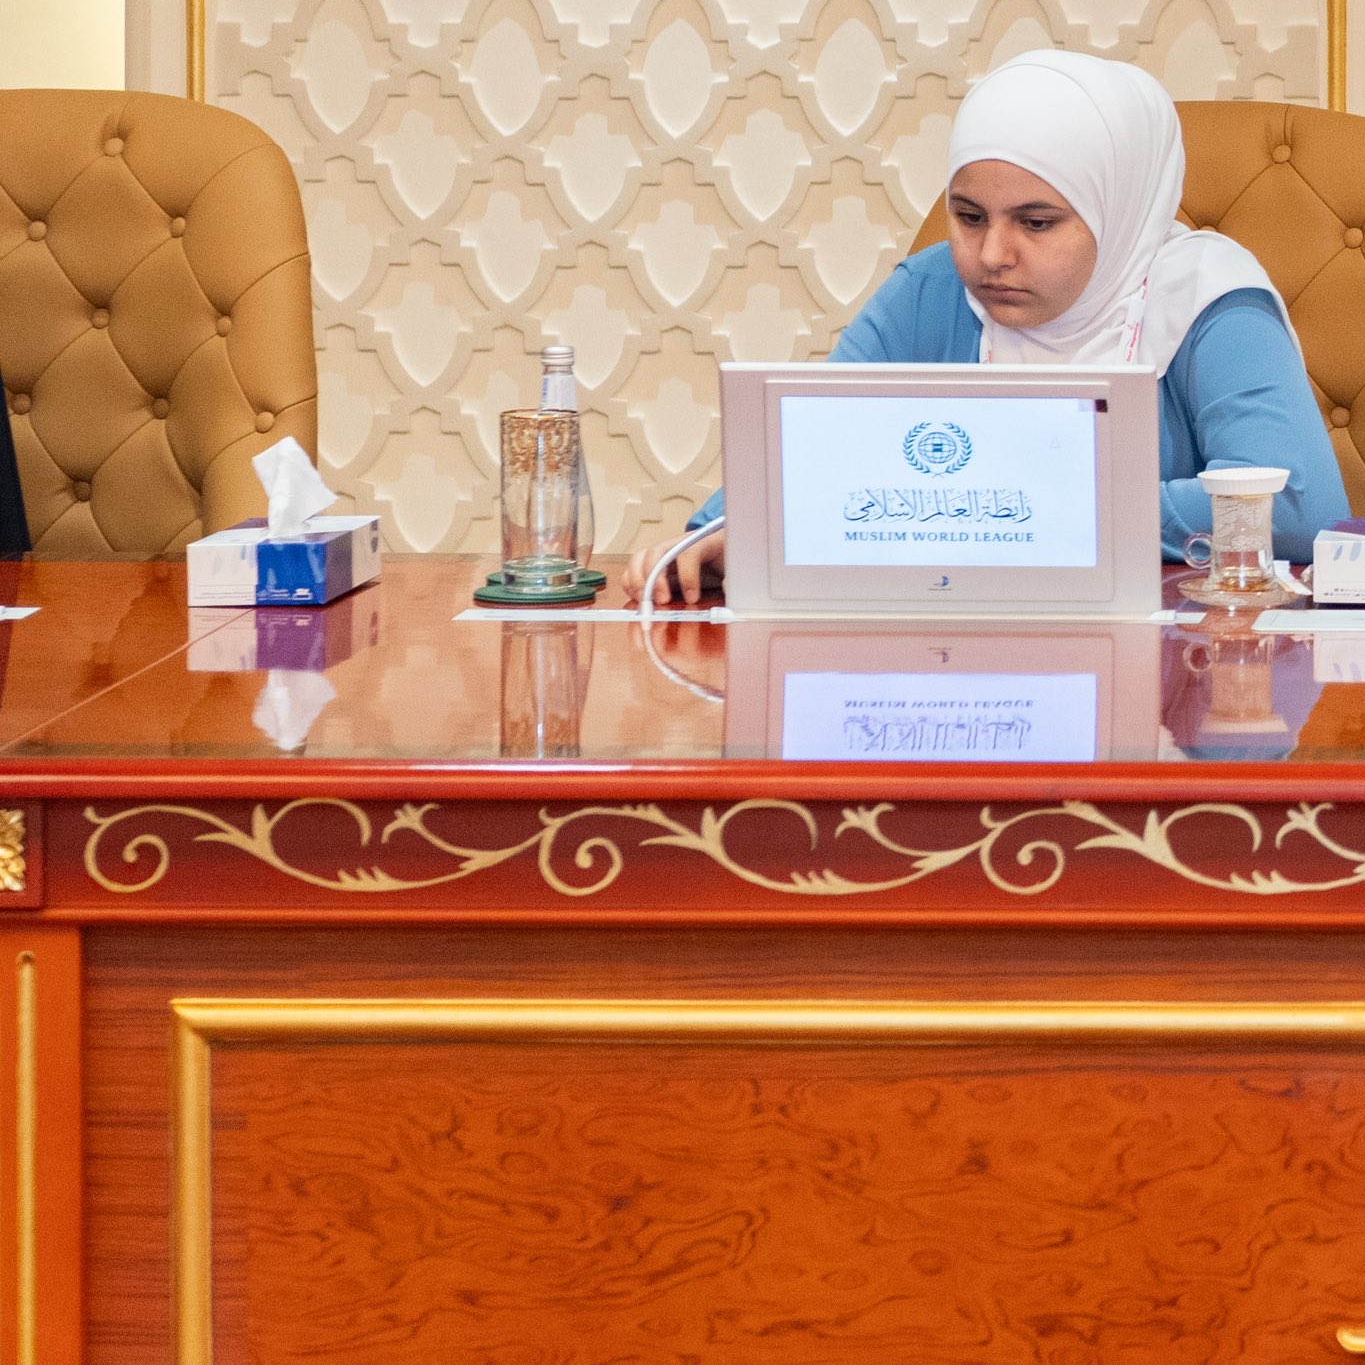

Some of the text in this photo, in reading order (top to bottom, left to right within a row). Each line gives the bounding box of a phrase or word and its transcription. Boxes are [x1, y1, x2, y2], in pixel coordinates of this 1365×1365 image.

[844, 531, 1034, 542] MUSLIM WORLD LEAGUE
